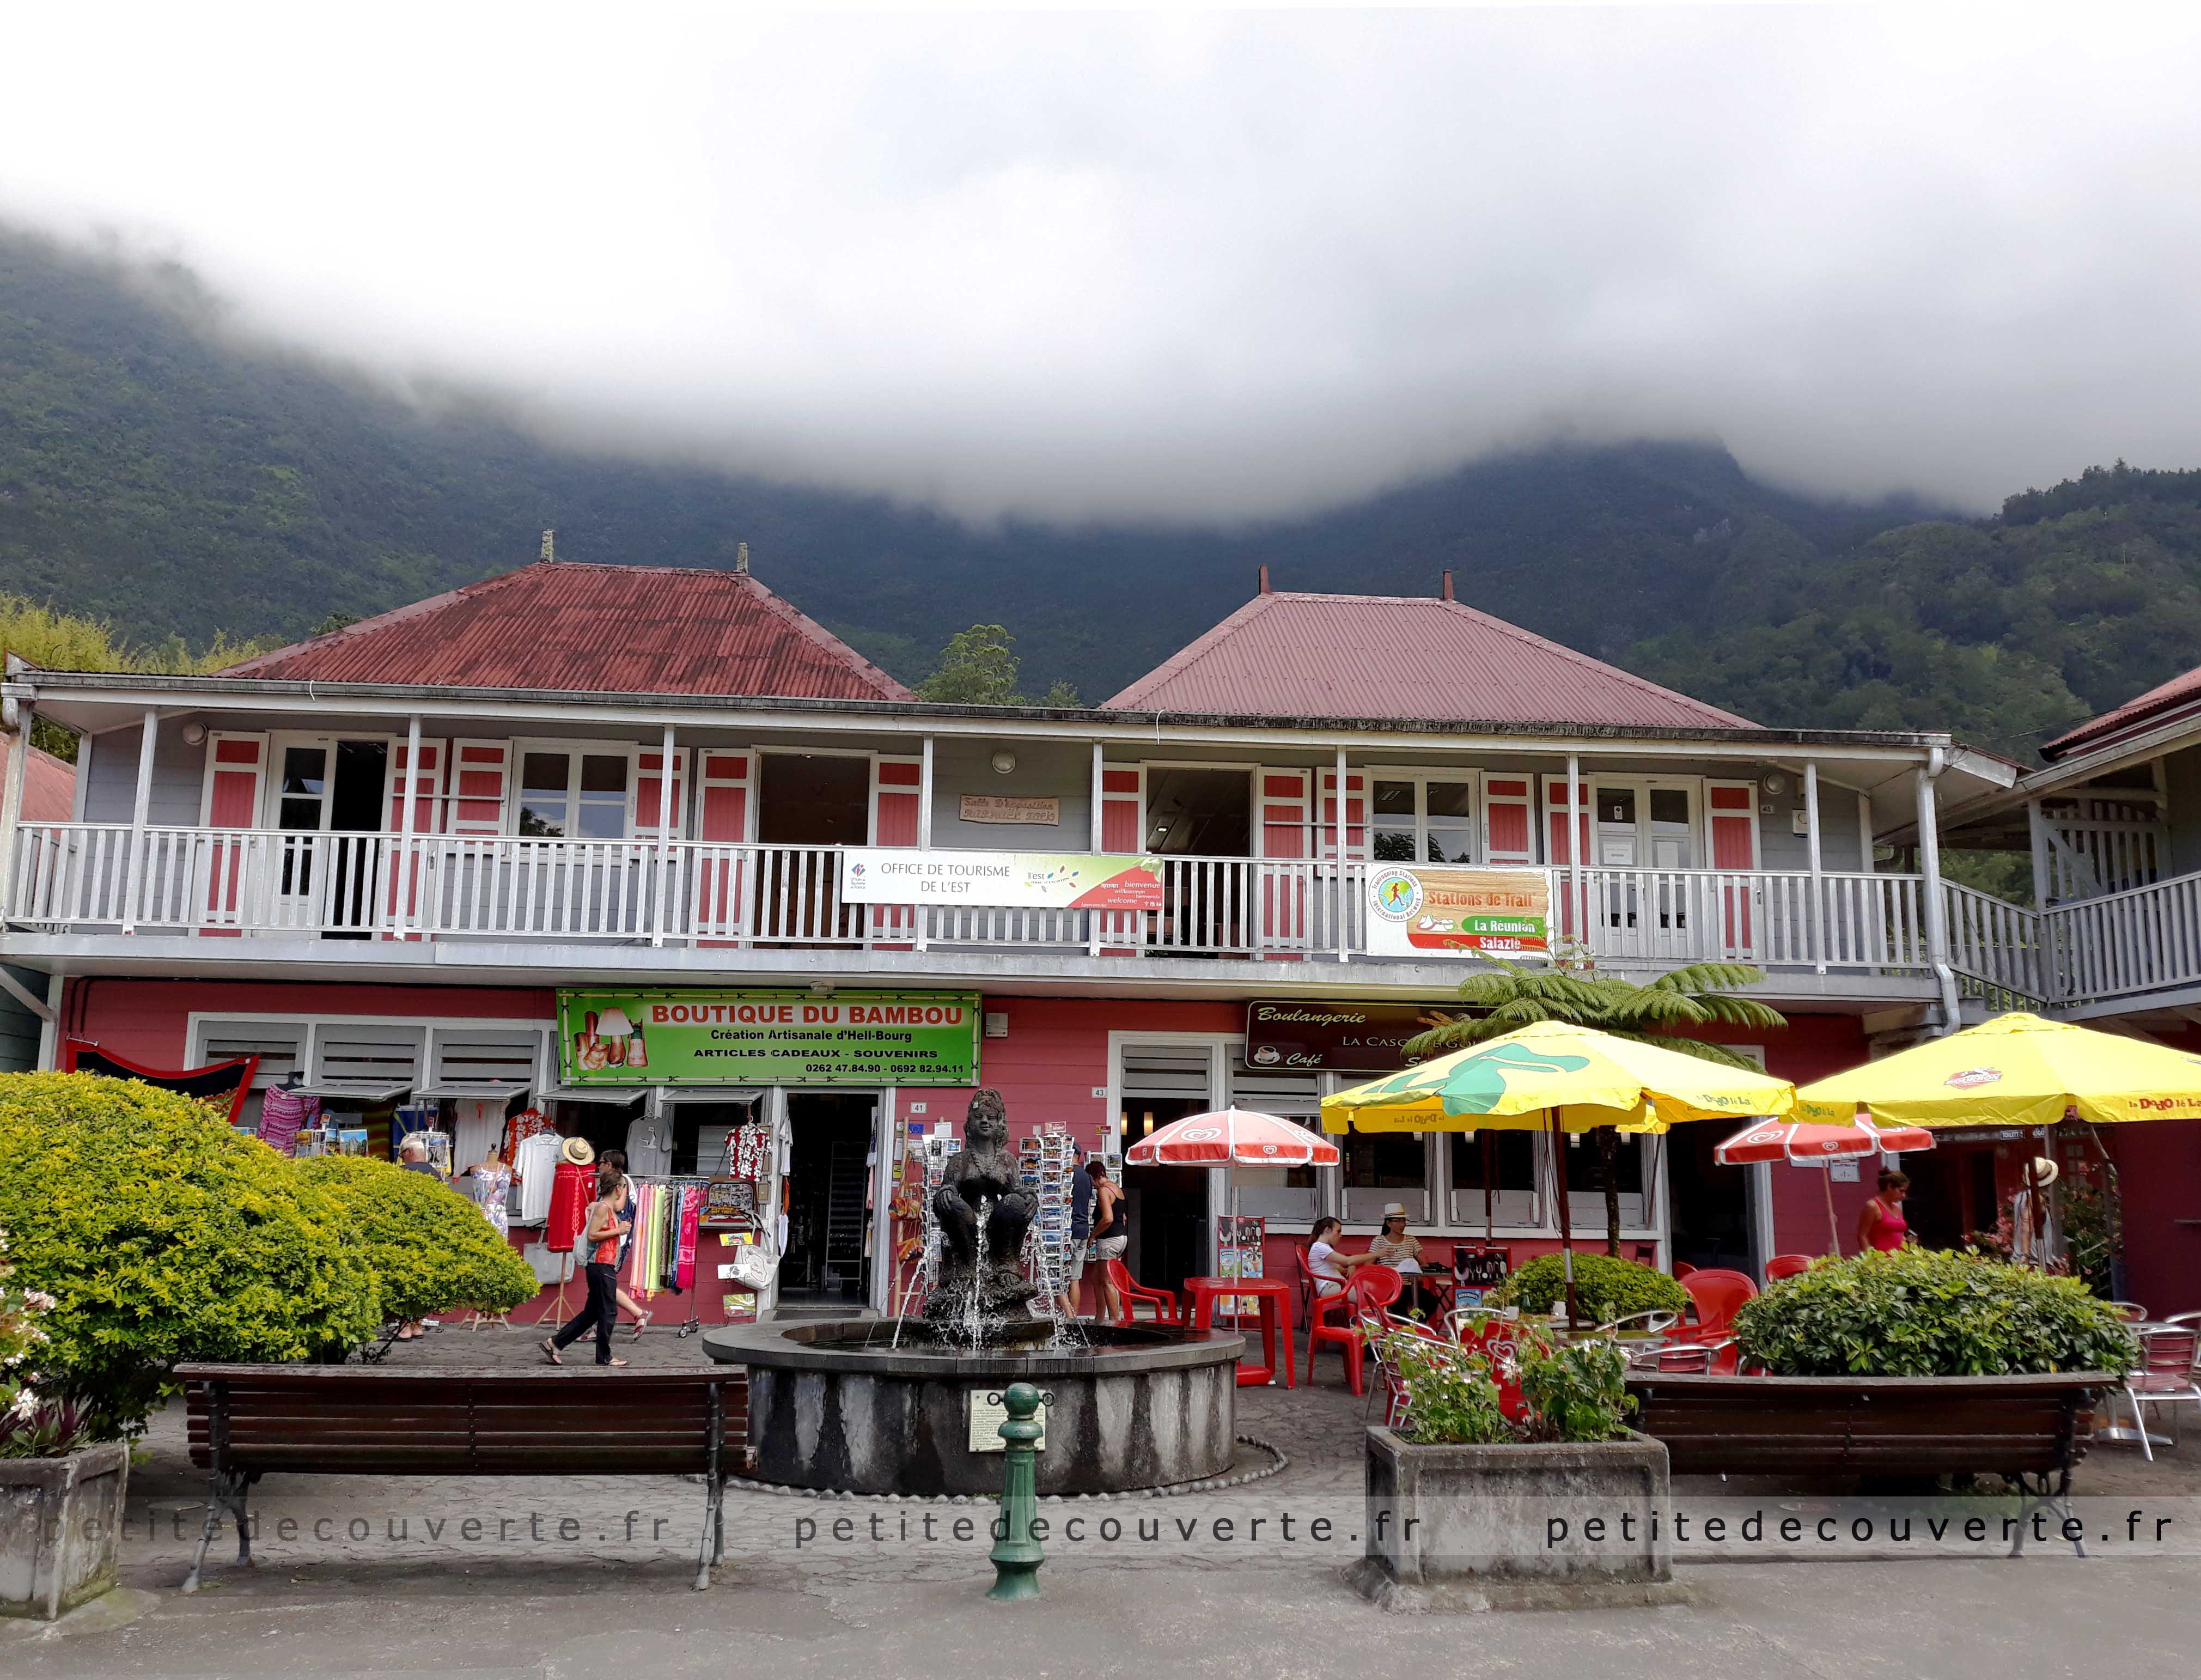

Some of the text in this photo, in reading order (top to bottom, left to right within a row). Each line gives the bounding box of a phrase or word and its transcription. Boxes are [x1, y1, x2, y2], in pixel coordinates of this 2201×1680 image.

[881, 862, 1010, 877] OFFICE DE TOURISME
[921, 880, 971, 893] DE L'EST
[1124, 880, 1161, 888] bienvenue
[1428, 891, 1533, 907] Stations de Trail
[1474, 920, 1536, 933] La Réunion
[1479, 936, 1521, 950] Salazie
[653, 1005, 962, 1025] BOUTIQUE DU BAMBOU
[1257, 1007, 1367, 1027] Boulangerie
[711, 1030, 912, 1043] Création Artisanale d'Hell-Bourg
[1342, 1036, 1361, 1046] LA
[693, 1049, 766, 1057] ARTICLES
[771, 1049, 840, 1058] CADEAUX
[853, 1050, 938, 1058] SOUVENIRS
[1286, 1052, 1323, 1067] Café
[806, 1064, 832, 1073] 0262
[835, 1064, 881, 1073] 47.84.90
[890, 1064, 916, 1073] 0692
[919, 1064, 964, 1073] 82.94.11
